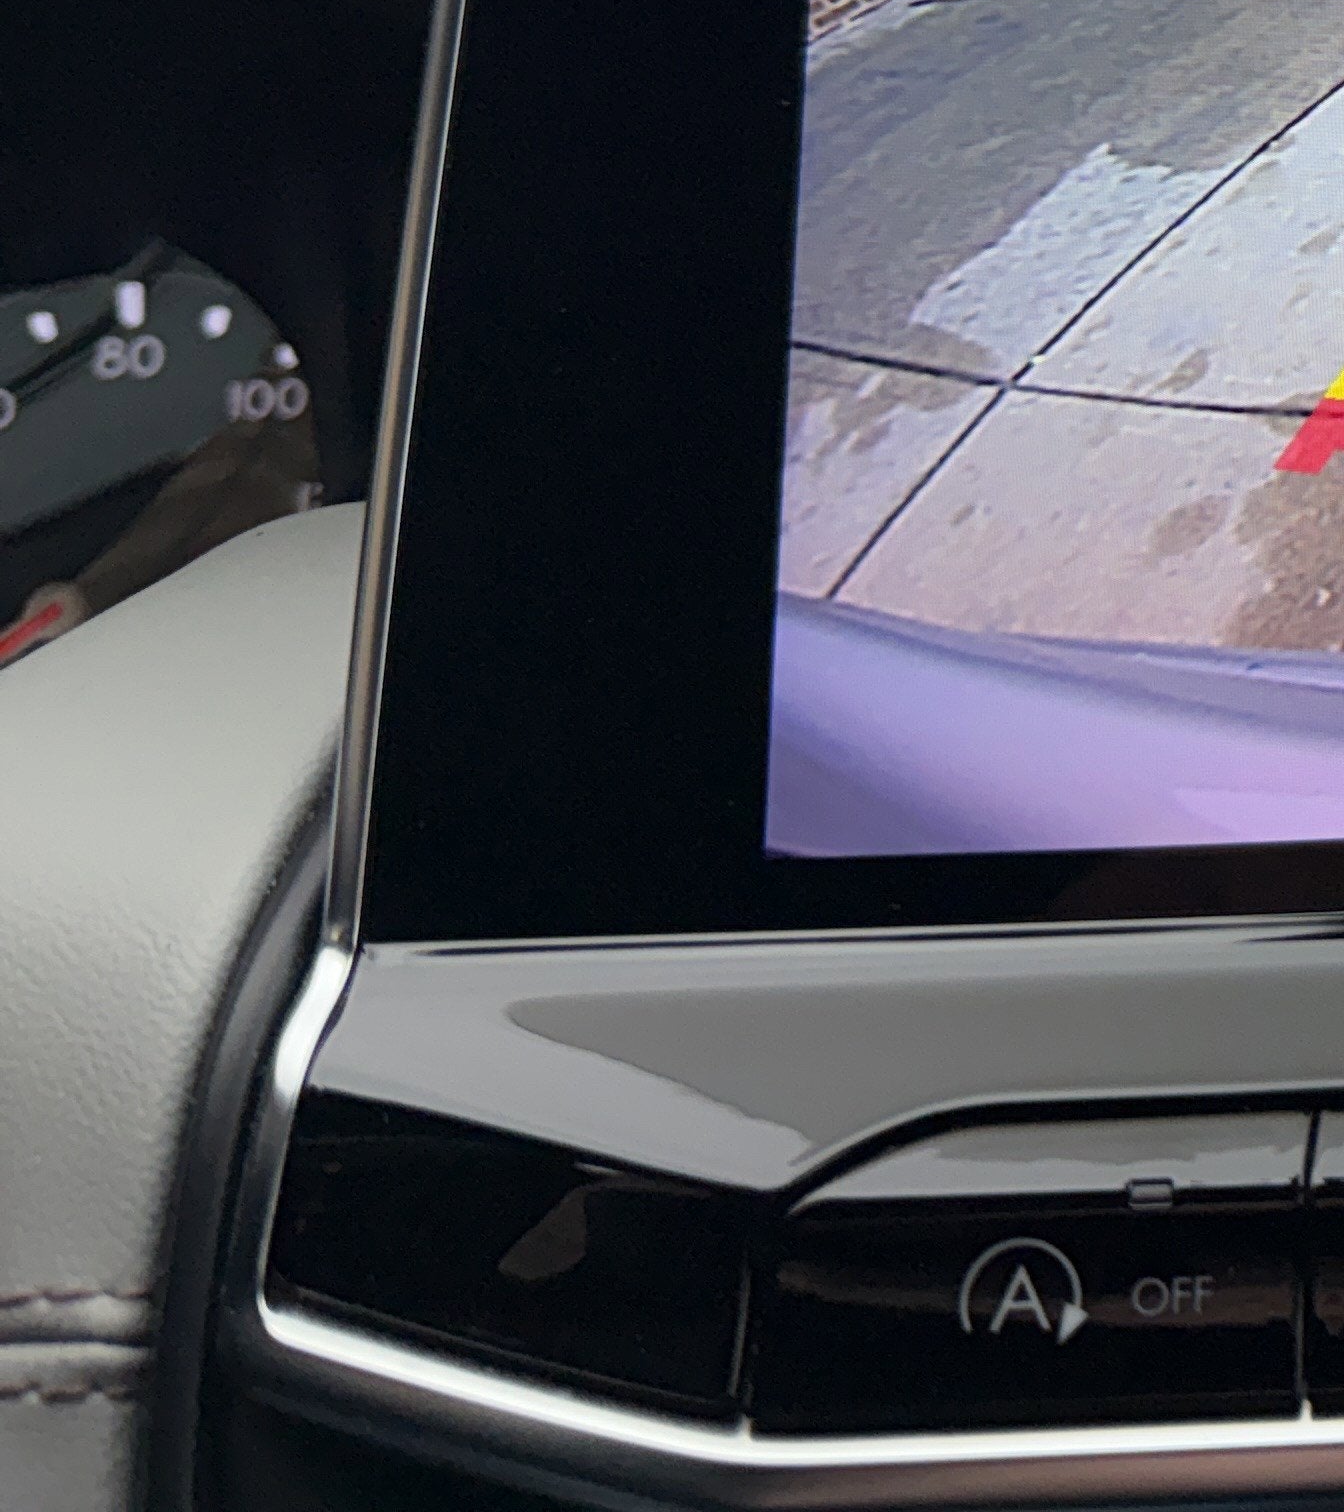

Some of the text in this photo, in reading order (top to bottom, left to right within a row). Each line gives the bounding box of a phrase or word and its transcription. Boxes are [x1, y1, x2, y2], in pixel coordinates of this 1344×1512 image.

[92, 335, 165, 380] 80
[227, 377, 309, 421] 100
[1131, 1276, 1214, 1317] OFF
